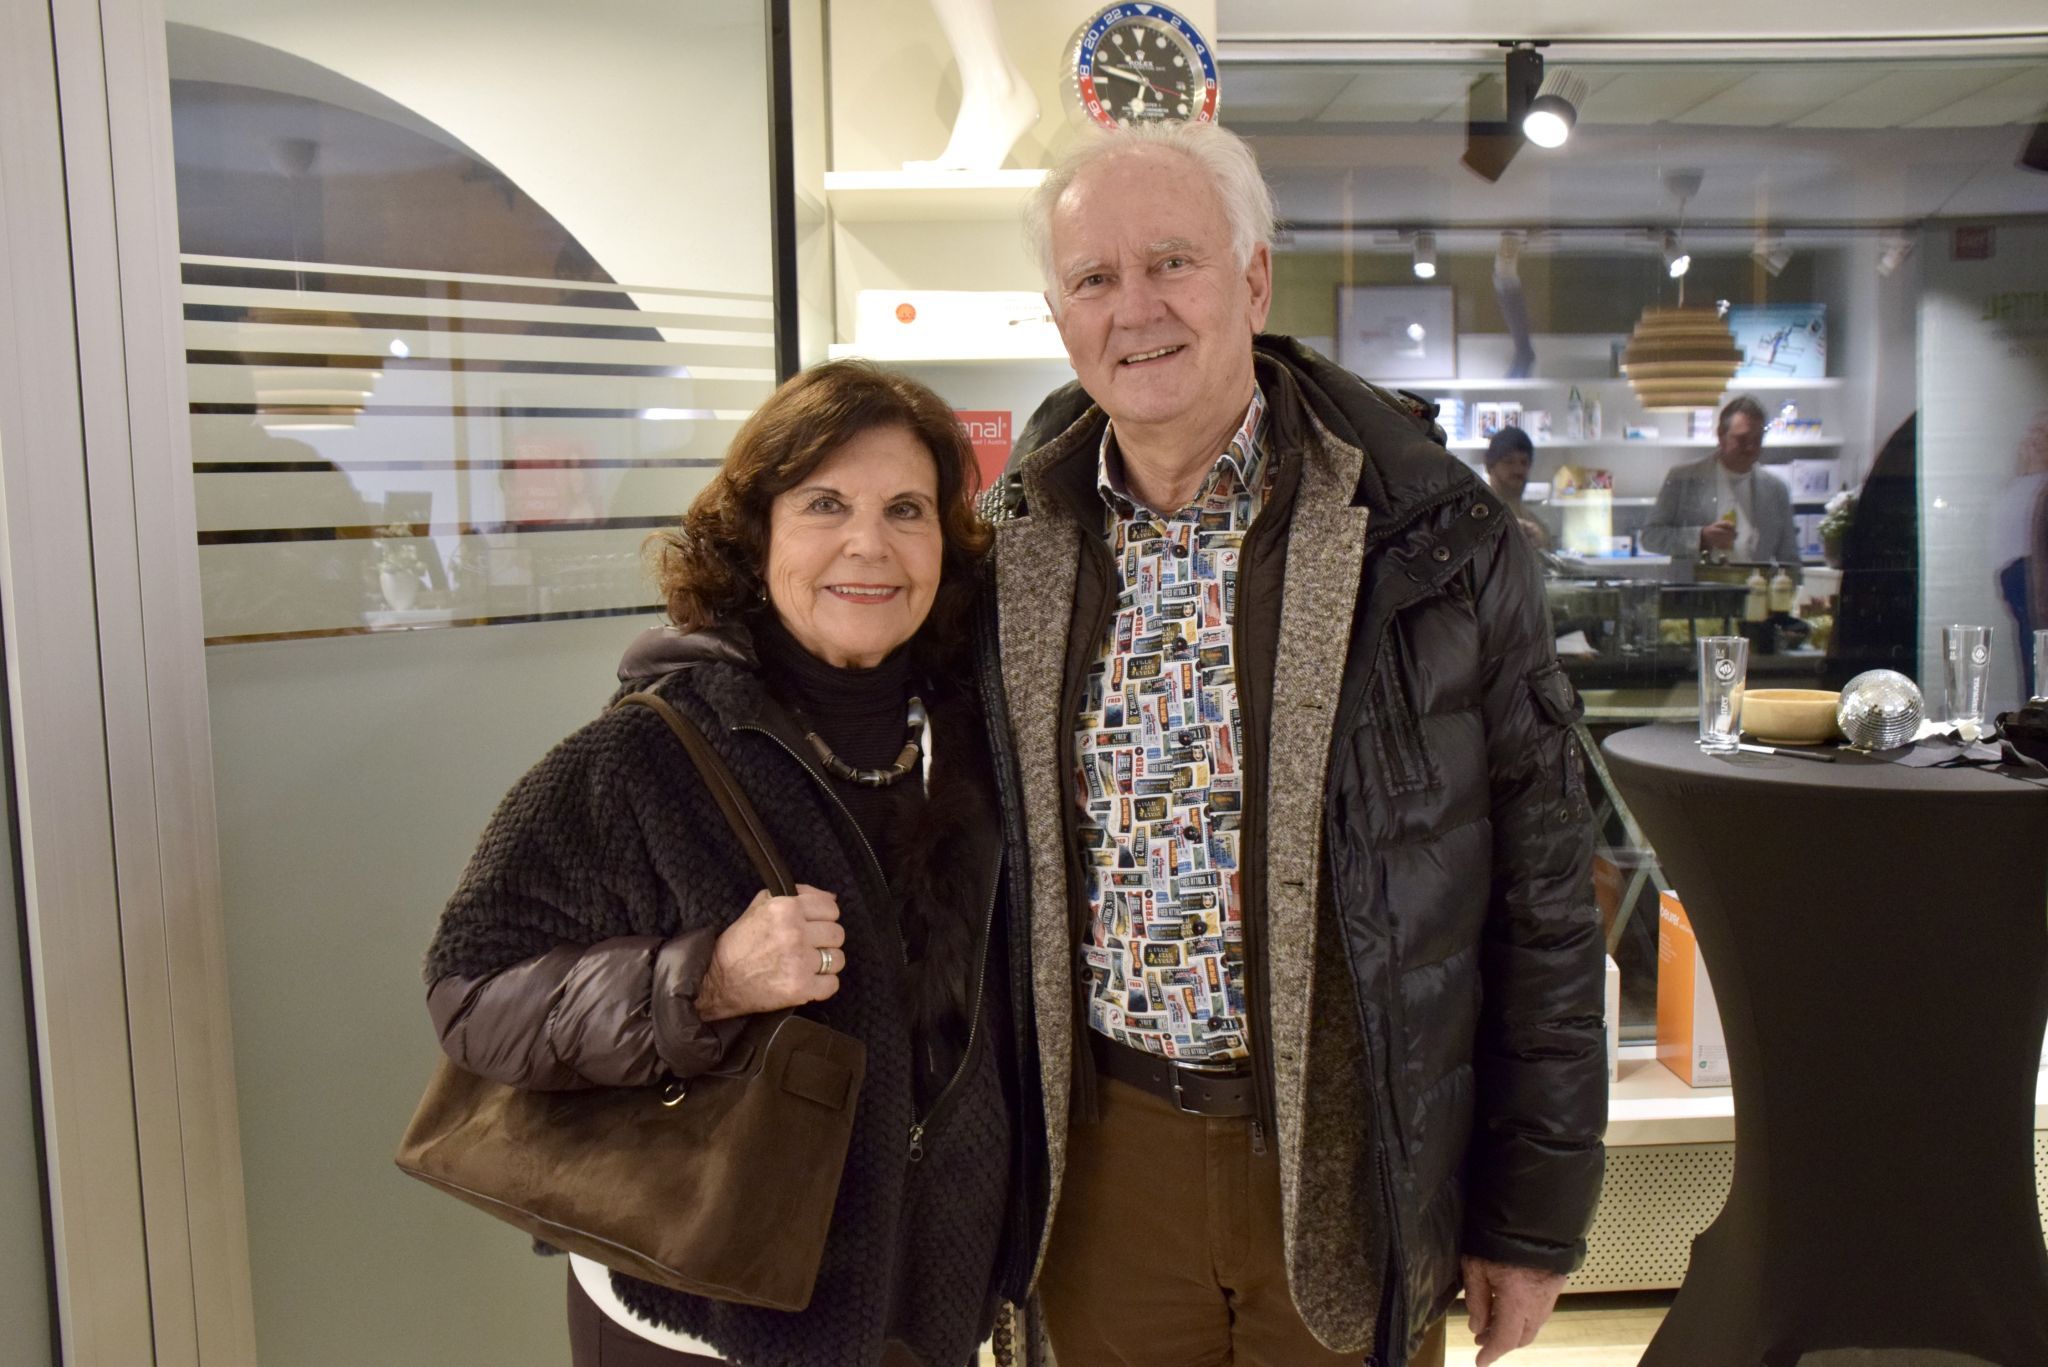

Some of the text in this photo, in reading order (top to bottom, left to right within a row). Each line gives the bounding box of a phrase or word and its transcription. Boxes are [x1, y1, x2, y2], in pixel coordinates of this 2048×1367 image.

[1104, 8, 1123, 25] 22
[1170, 16, 1182, 29] 2
[1084, 30, 1099, 50] 20
[1195, 44, 1206, 54] 4
[1080, 64, 1090, 81] 18
[1206, 78, 1216, 90] 6
[1088, 100, 1102, 118] 16
[1136, 757, 1144, 777] FRED
[1145, 900, 1154, 921] FRED
